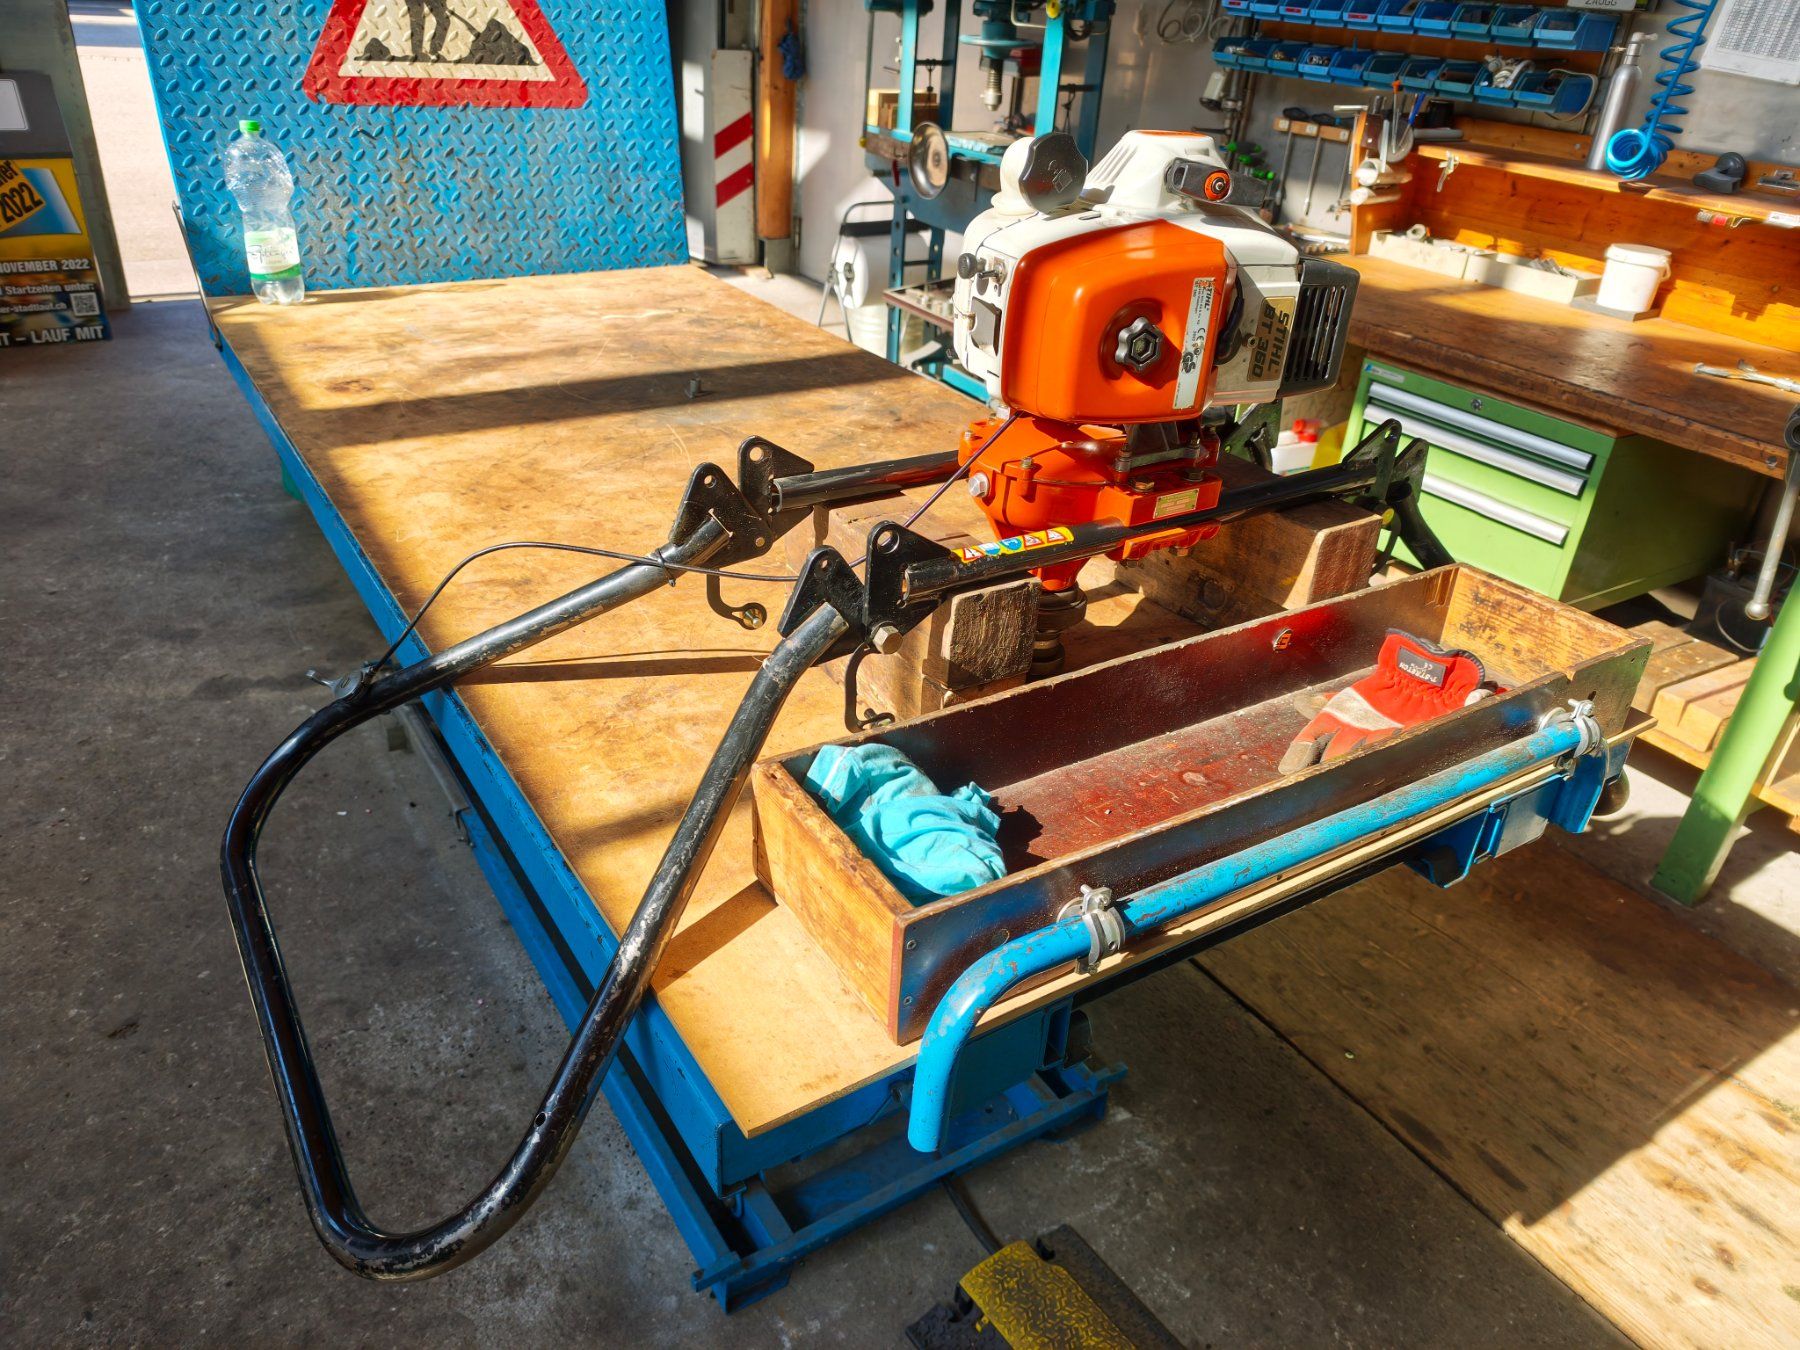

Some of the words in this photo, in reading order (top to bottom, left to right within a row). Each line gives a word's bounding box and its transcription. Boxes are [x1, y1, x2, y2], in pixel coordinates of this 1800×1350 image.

[0, 182, 43, 223] 2022
[62, 258, 90, 270] 2022
[5, 284, 62, 295] Startzeiten
[64, 283, 95, 291] unter:
[1262, 303, 1275, 334] BT
[31, 328, 70, 343] LAUF
[75, 326, 104, 340] MIT
[1267, 310, 1290, 371] STIHL
[1182, 351, 1196, 374] GS
[1399, 662, 1438, 682] T-STRETCH
